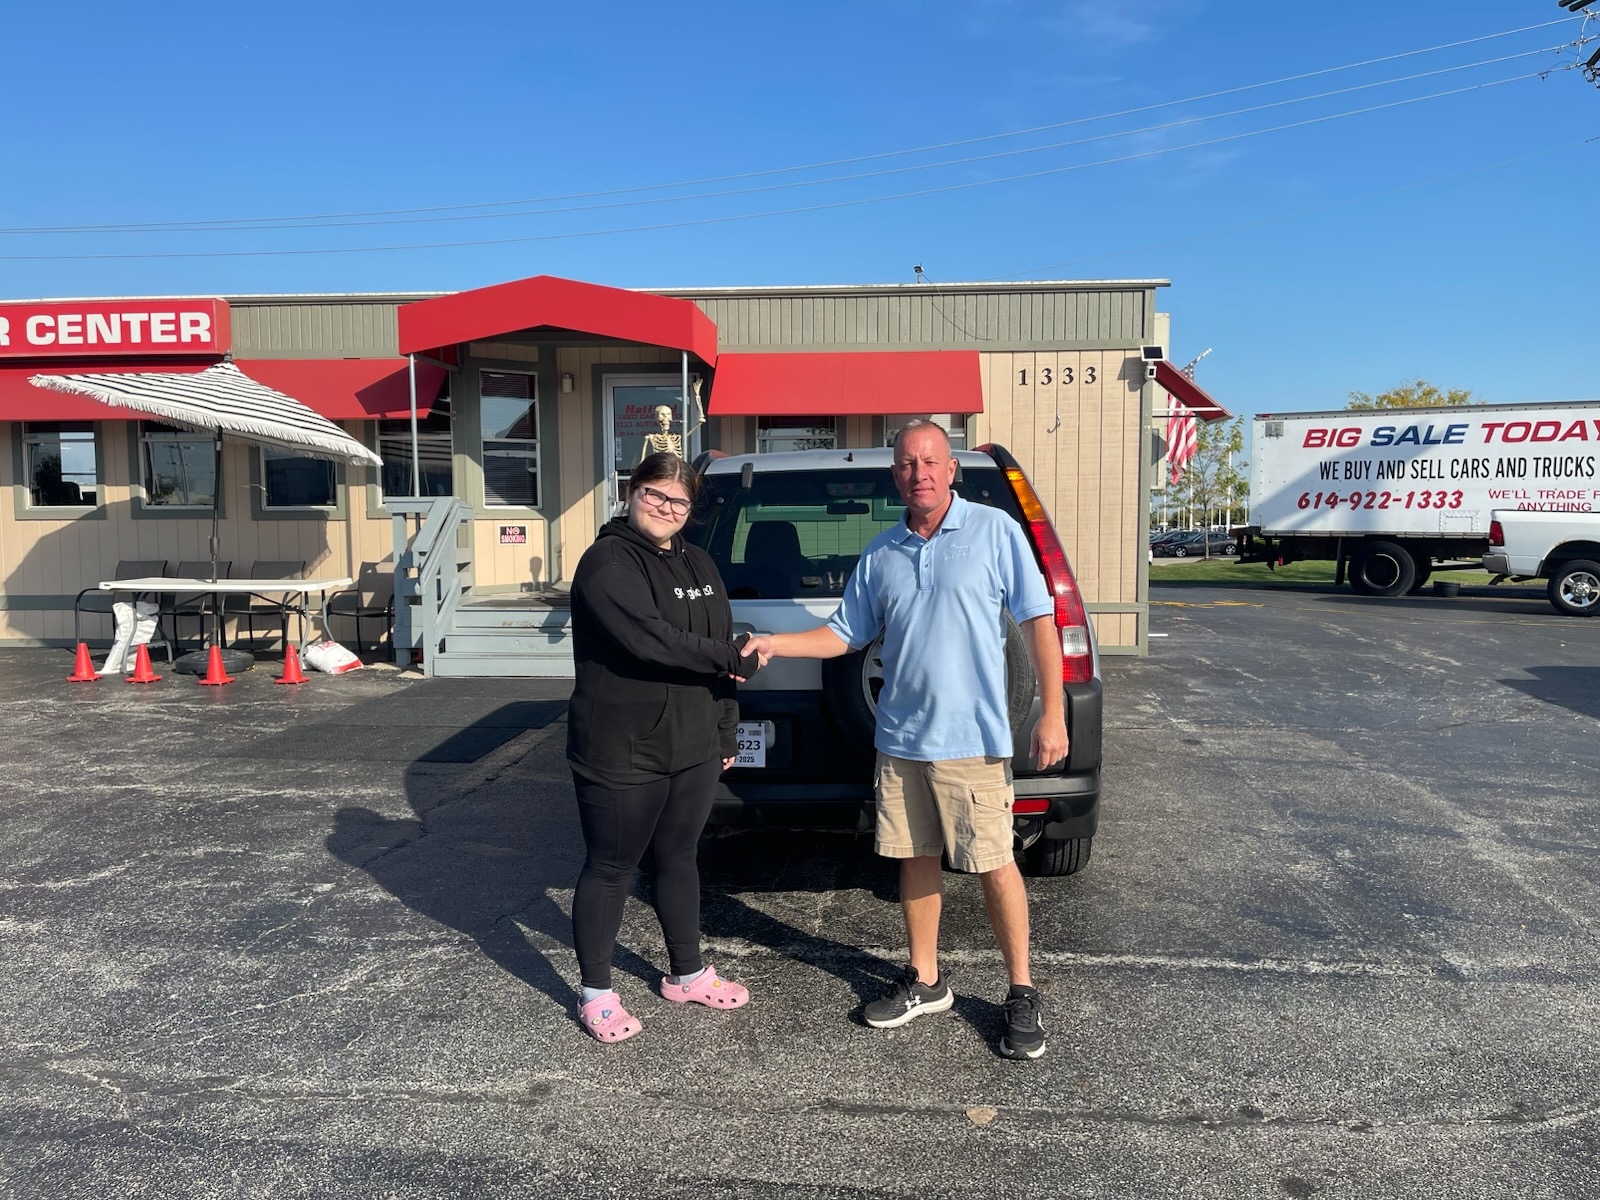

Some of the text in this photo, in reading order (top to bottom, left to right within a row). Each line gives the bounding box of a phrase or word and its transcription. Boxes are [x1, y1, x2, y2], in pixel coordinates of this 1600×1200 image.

[26, 312, 211, 345] CENTER
[1018, 366, 1097, 386] 1333
[1302, 427, 1362, 448] BIG
[1370, 423, 1469, 446] SALE
[1320, 456, 1595, 480] WE BUY AND SELL CARS AND TRUCKS
[1298, 491, 1464, 510] 614-922-1333
[1488, 490, 1531, 499] WE'LL
[1537, 490, 1586, 499] TRADE
[1517, 502, 1592, 512] ANYTHING
[506, 526, 520, 534] NO
[737, 740, 761, 750] 623
